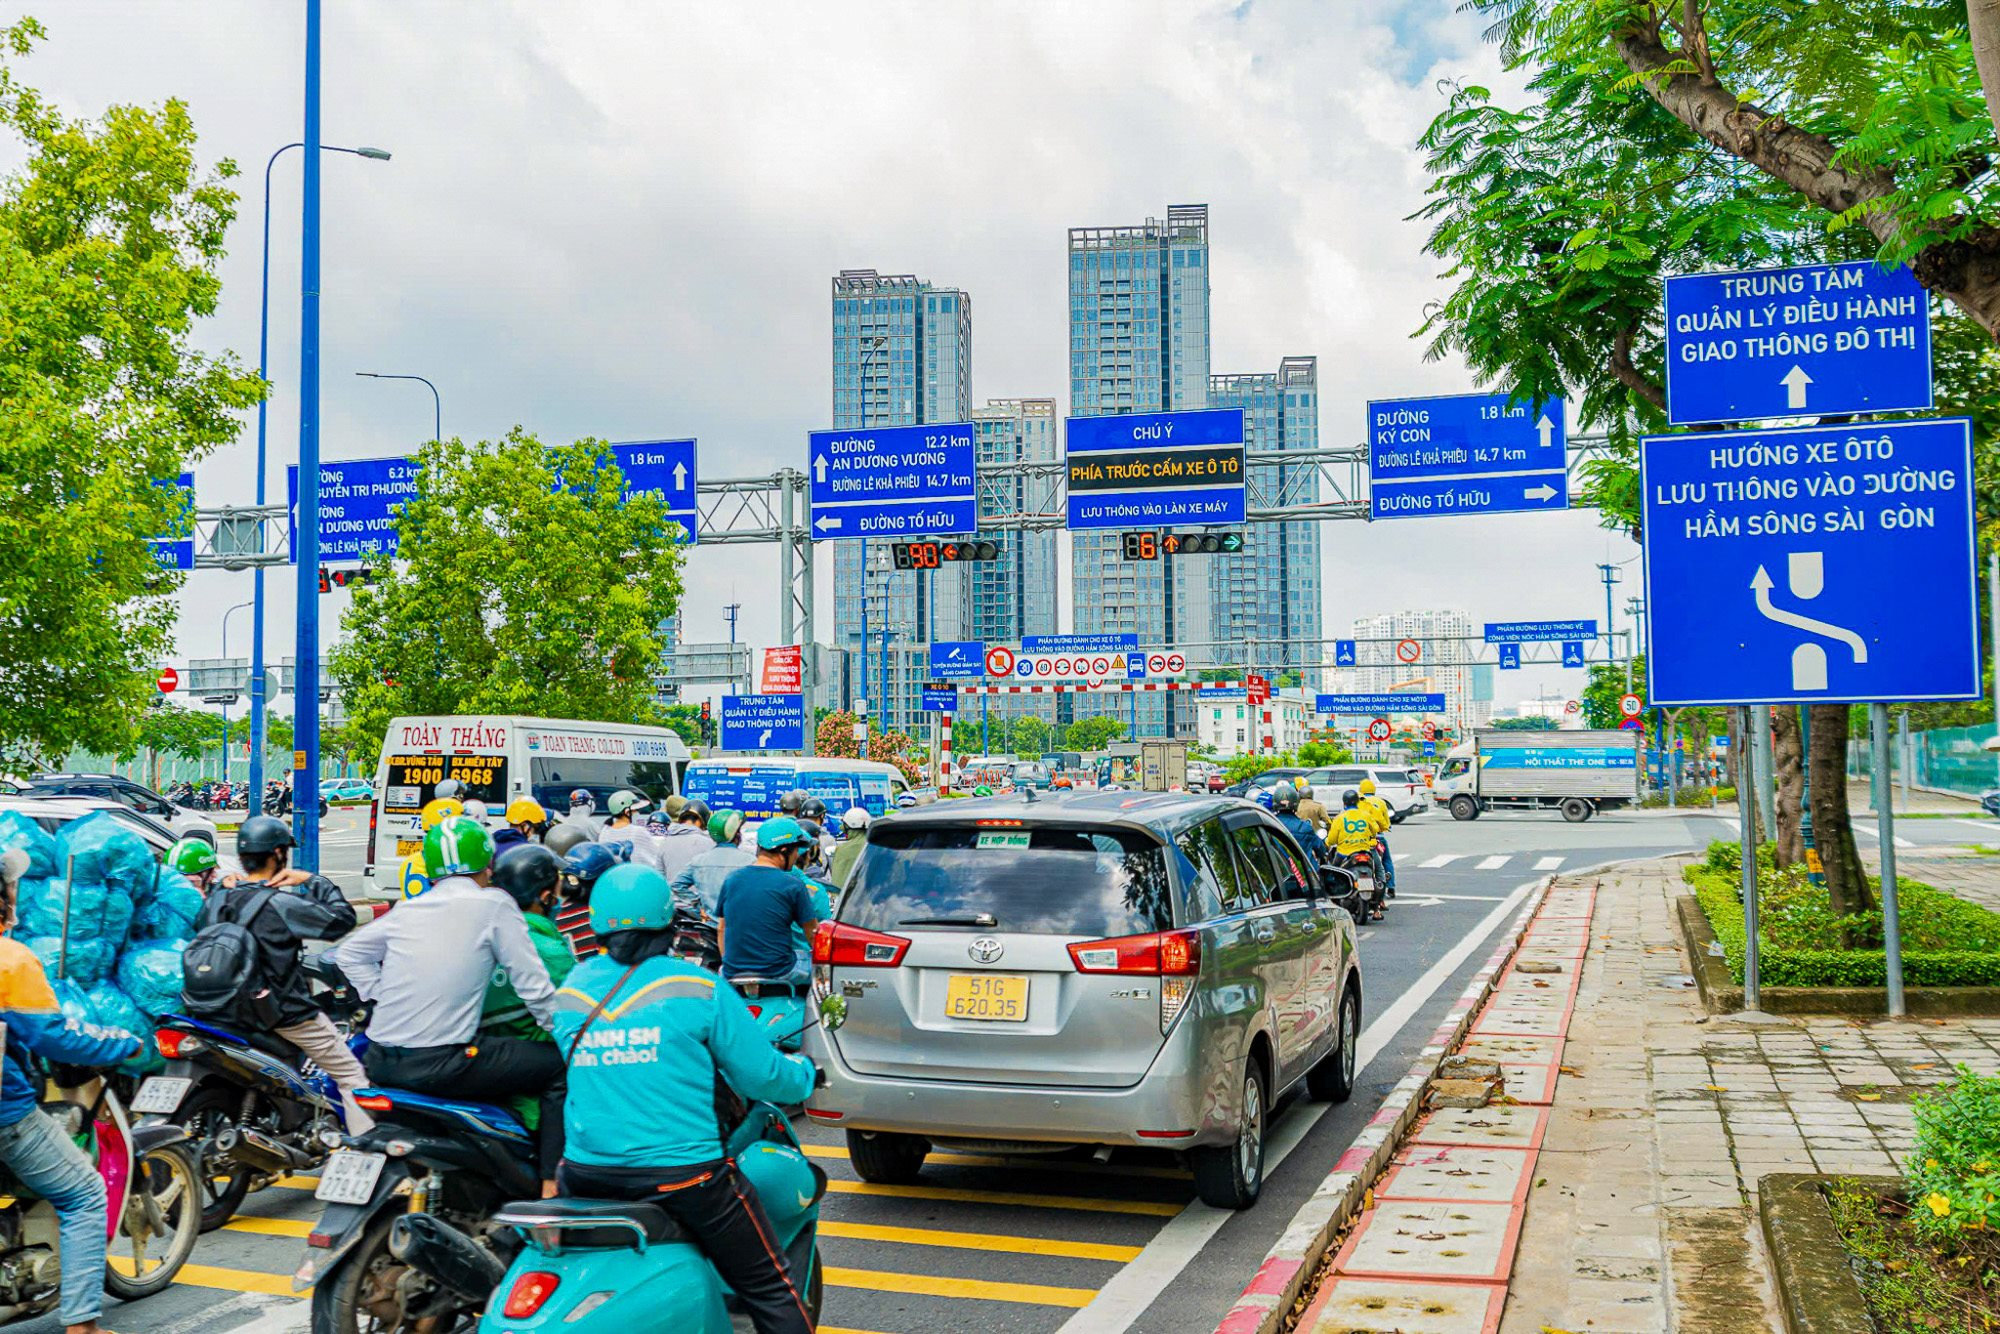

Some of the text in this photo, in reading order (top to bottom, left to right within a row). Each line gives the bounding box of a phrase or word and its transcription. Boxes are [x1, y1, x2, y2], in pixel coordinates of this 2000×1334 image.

[1720, 267, 1864, 299] TRUNG TÂM
[1676, 295, 1916, 333] QUẢN LÝ ĐIỀU HÀNH
[1681, 326, 1916, 363] GIAO THÔNG ĐÔ THỊ
[1376, 409, 1429, 427] ĐƯỜNG
[1480, 406, 1498, 420] 1.8
[1133, 422, 1173, 439] CHÚ Ý
[1377, 428, 1430, 444] KÝ CON
[831, 435, 970, 453] ĐƯỜNG 12.2 km
[1710, 435, 1893, 469] HƯỚNG XE ÔTÔ
[630, 453, 665, 465] 1.8 km
[832, 452, 946, 470] AN DƯƠNG VƯƠNG
[1379, 447, 1526, 468] ĐƯỜNG LÊ KHẢ PHIÊU 14.7 km
[389, 467, 404, 479] 6.2
[1071, 457, 1238, 480] PHÍA TRƯỚC CẤM XE Ô TÔ
[352, 482, 417, 497] TRI PHƯƠNG
[833, 473, 971, 492] ĐƯỜNG LÊ KHẢ PHIÊU 14.7 km
[1657, 482, 1706, 505] LƯU
[1713, 476, 1798, 502] THÔNG
[1804, 472, 1855, 497] VÀO
[1081, 500, 1228, 518] LƯU THÔNG VÀO LÀN XE MÁY
[1379, 489, 1490, 511] ĐƯỜNG TỐ HỮU
[327, 520, 363, 534] DƯƠNG
[860, 511, 954, 530] ĐƯỜNG TỐ HỮU
[1685, 502, 1934, 539] HẦM SÔNG SÀI GÒN
[1140, 533, 1155, 559] 6
[909, 543, 939, 568] 90
[1020, 662, 1030, 673] 30
[739, 696, 784, 706] TRUNG TÂM
[1626, 700, 1637, 711] 50
[725, 707, 746, 717] QUẢN
[748, 707, 757, 716] LÝ
[778, 706, 800, 715] HÀNH
[726, 720, 745, 728] GIAO
[747, 718, 773, 728] THÔNG
[402, 721, 442, 746] TOÀN
[450, 720, 506, 748] THẮNG
[543, 735, 565, 752] TOAN
[568, 736, 595, 753] THANG
[1568, 758, 1585, 766] THE
[1587, 758, 1606, 766] ONE
[404, 768, 493, 785] 1900 6968
[1344, 817, 1367, 834] be
[981, 836, 989, 845] XE
[971, 979, 1004, 996] 51G
[955, 998, 1017, 1017] 620.35
[628, 1026, 660, 1045] SM
[602, 1046, 658, 1066] chào!
